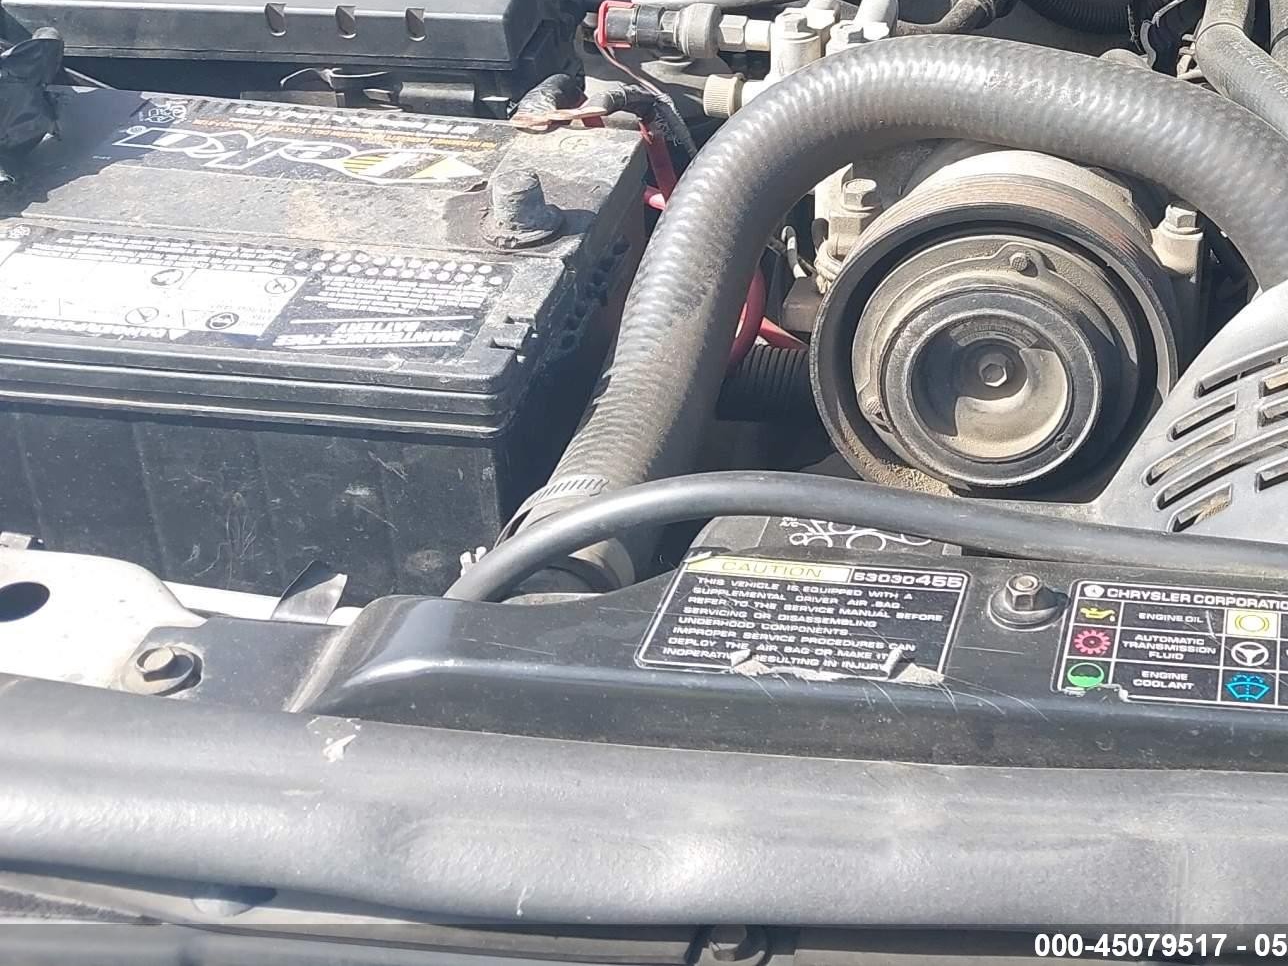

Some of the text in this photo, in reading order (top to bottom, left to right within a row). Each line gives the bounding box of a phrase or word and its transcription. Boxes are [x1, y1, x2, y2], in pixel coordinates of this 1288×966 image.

[721, 562, 963, 588] CAUTION 53030455
[696, 576, 726, 586] THIS
[731, 580, 781, 591] VEHICLE
[787, 584, 800, 592] IS
[802, 586, 863, 597] EQUIPPED
[868, 590, 899, 600] WITH
[1107, 587, 1191, 604] CHRYSLER
[692, 587, 787, 601] SUPPLEMENTAL
[795, 595, 839, 605] DRIVER
[846, 599, 869, 607] AIR
[683, 606, 878, 628] SERVICING OR DISASSEMBLING
[687, 596, 944, 622] REFER TO THE SERVICE MANUAL BEFORE
[678, 616, 756, 629] UNDERHOOD
[1138, 612, 1204, 624] ENGINE OIL
[672, 626, 916, 652] IMPROPER SERVICE PROCEDURES CAN
[1134, 634, 1205, 646] AUTOMATIC
[667, 637, 717, 648] DEPLOY
[725, 641, 750, 650] THE
[756, 643, 778, 652] AIR
[784, 646, 810, 655] BAG
[814, 648, 833, 657] OR
[837, 650, 872, 660] MAKE
[1122, 640, 1217, 655] TRANSMISSION
[1148, 650, 1185, 660] FLUID
[822, 659, 837, 668] IN
[1141, 670, 1189, 681] ENGINE
[1133, 679, 1195, 690] COOLANT
